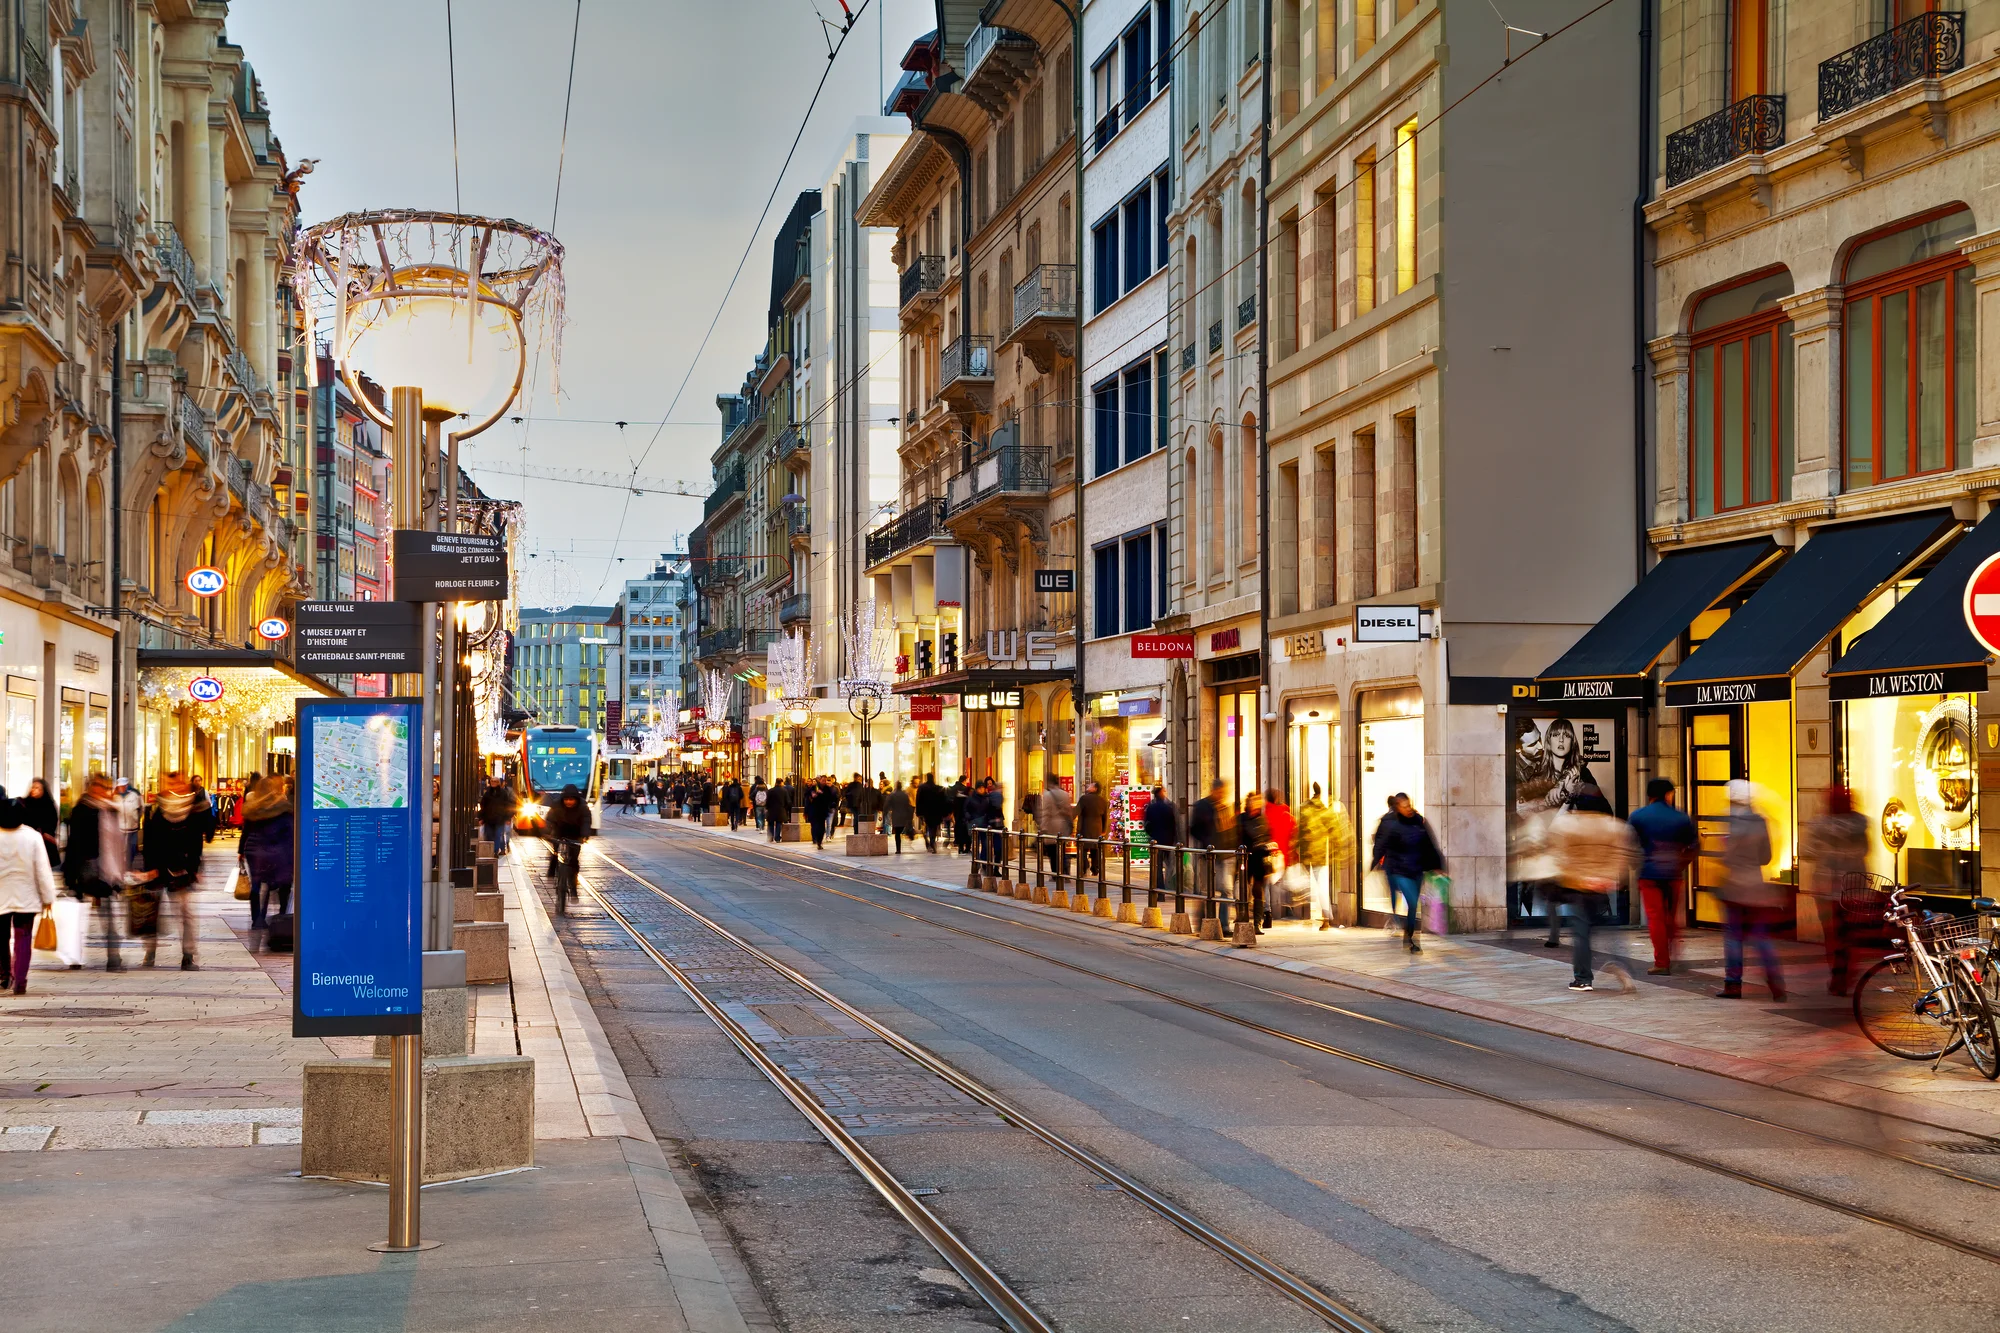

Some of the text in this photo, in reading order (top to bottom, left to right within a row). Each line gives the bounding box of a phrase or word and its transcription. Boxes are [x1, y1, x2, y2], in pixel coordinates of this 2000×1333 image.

[437, 535, 494, 546] GENEVE TOURISME &
[431, 544, 455, 553] BUREAU
[456, 546, 467, 554] DES
[474, 555, 495, 563] D'EAU
[435, 579, 495, 588] HORLOGE FLEURIE
[1040, 574, 1069, 588] WE
[307, 604, 354, 613] VIEILLE VILLE
[937, 599, 961, 608] Bata
[1360, 618, 1416, 628] DIESEL
[334, 628, 356, 636] D'ART
[357, 628, 367, 636] ET
[307, 638, 348, 646] D'HISTOIRE
[1210, 627, 1240, 652] BELDONA
[1284, 630, 1325, 657] DIESEL
[986, 630, 1057, 662] WE
[1137, 642, 1193, 652] BELDONA
[355, 652, 406, 660] SAINT-PIERRE
[1563, 681, 1613, 698] J.M. WESTON
[1869, 672, 1944, 697] J.M. WESTON
[1512, 684, 1540, 698] DI
[1697, 683, 1757, 703] J.M. WESTON
[964, 694, 988, 710] WE
[991, 691, 1020, 706] WE
[911, 704, 942, 713] ESPRIT
[312, 972, 375, 986] Bienvenue
[353, 985, 409, 998] Welcome
